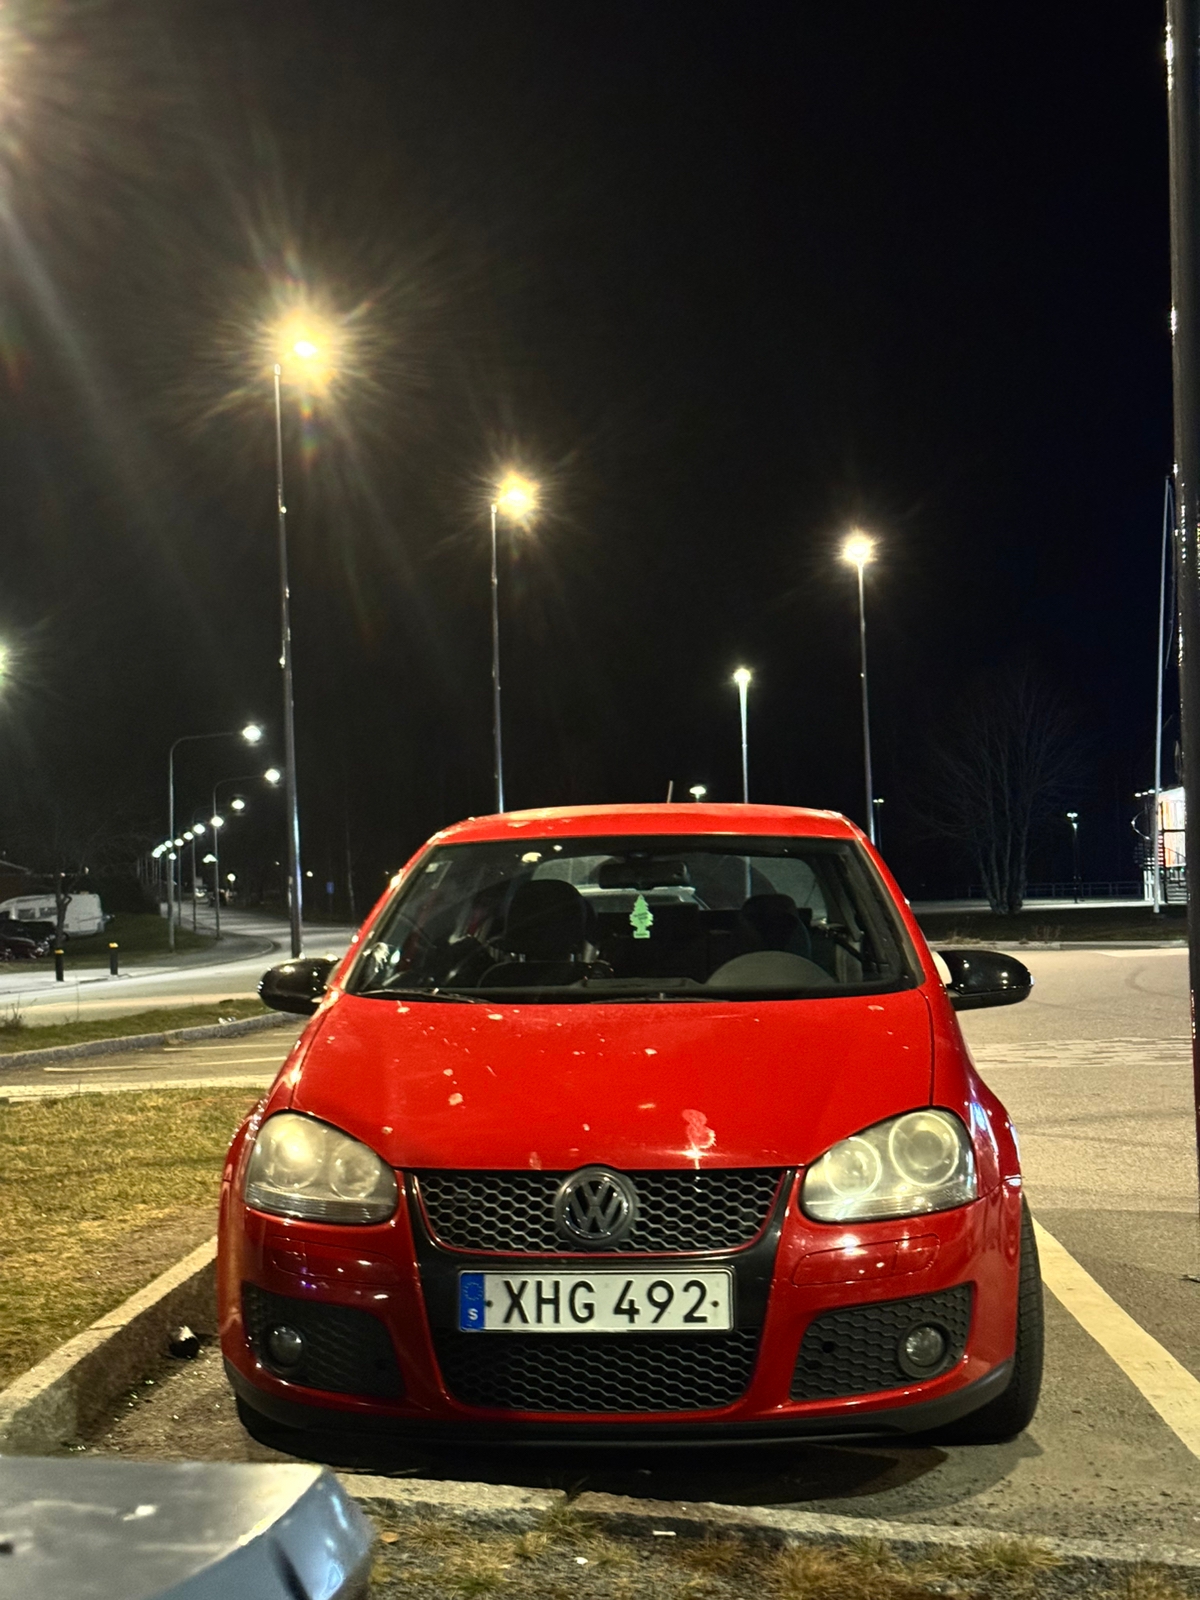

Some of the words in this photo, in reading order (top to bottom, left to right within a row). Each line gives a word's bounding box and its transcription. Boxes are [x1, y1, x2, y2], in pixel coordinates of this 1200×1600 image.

[562, 1177, 629, 1238] VW
[467, 1307, 479, 1321] S
[502, 1279, 595, 1324] XHG
[613, 1279, 708, 1324] 492
